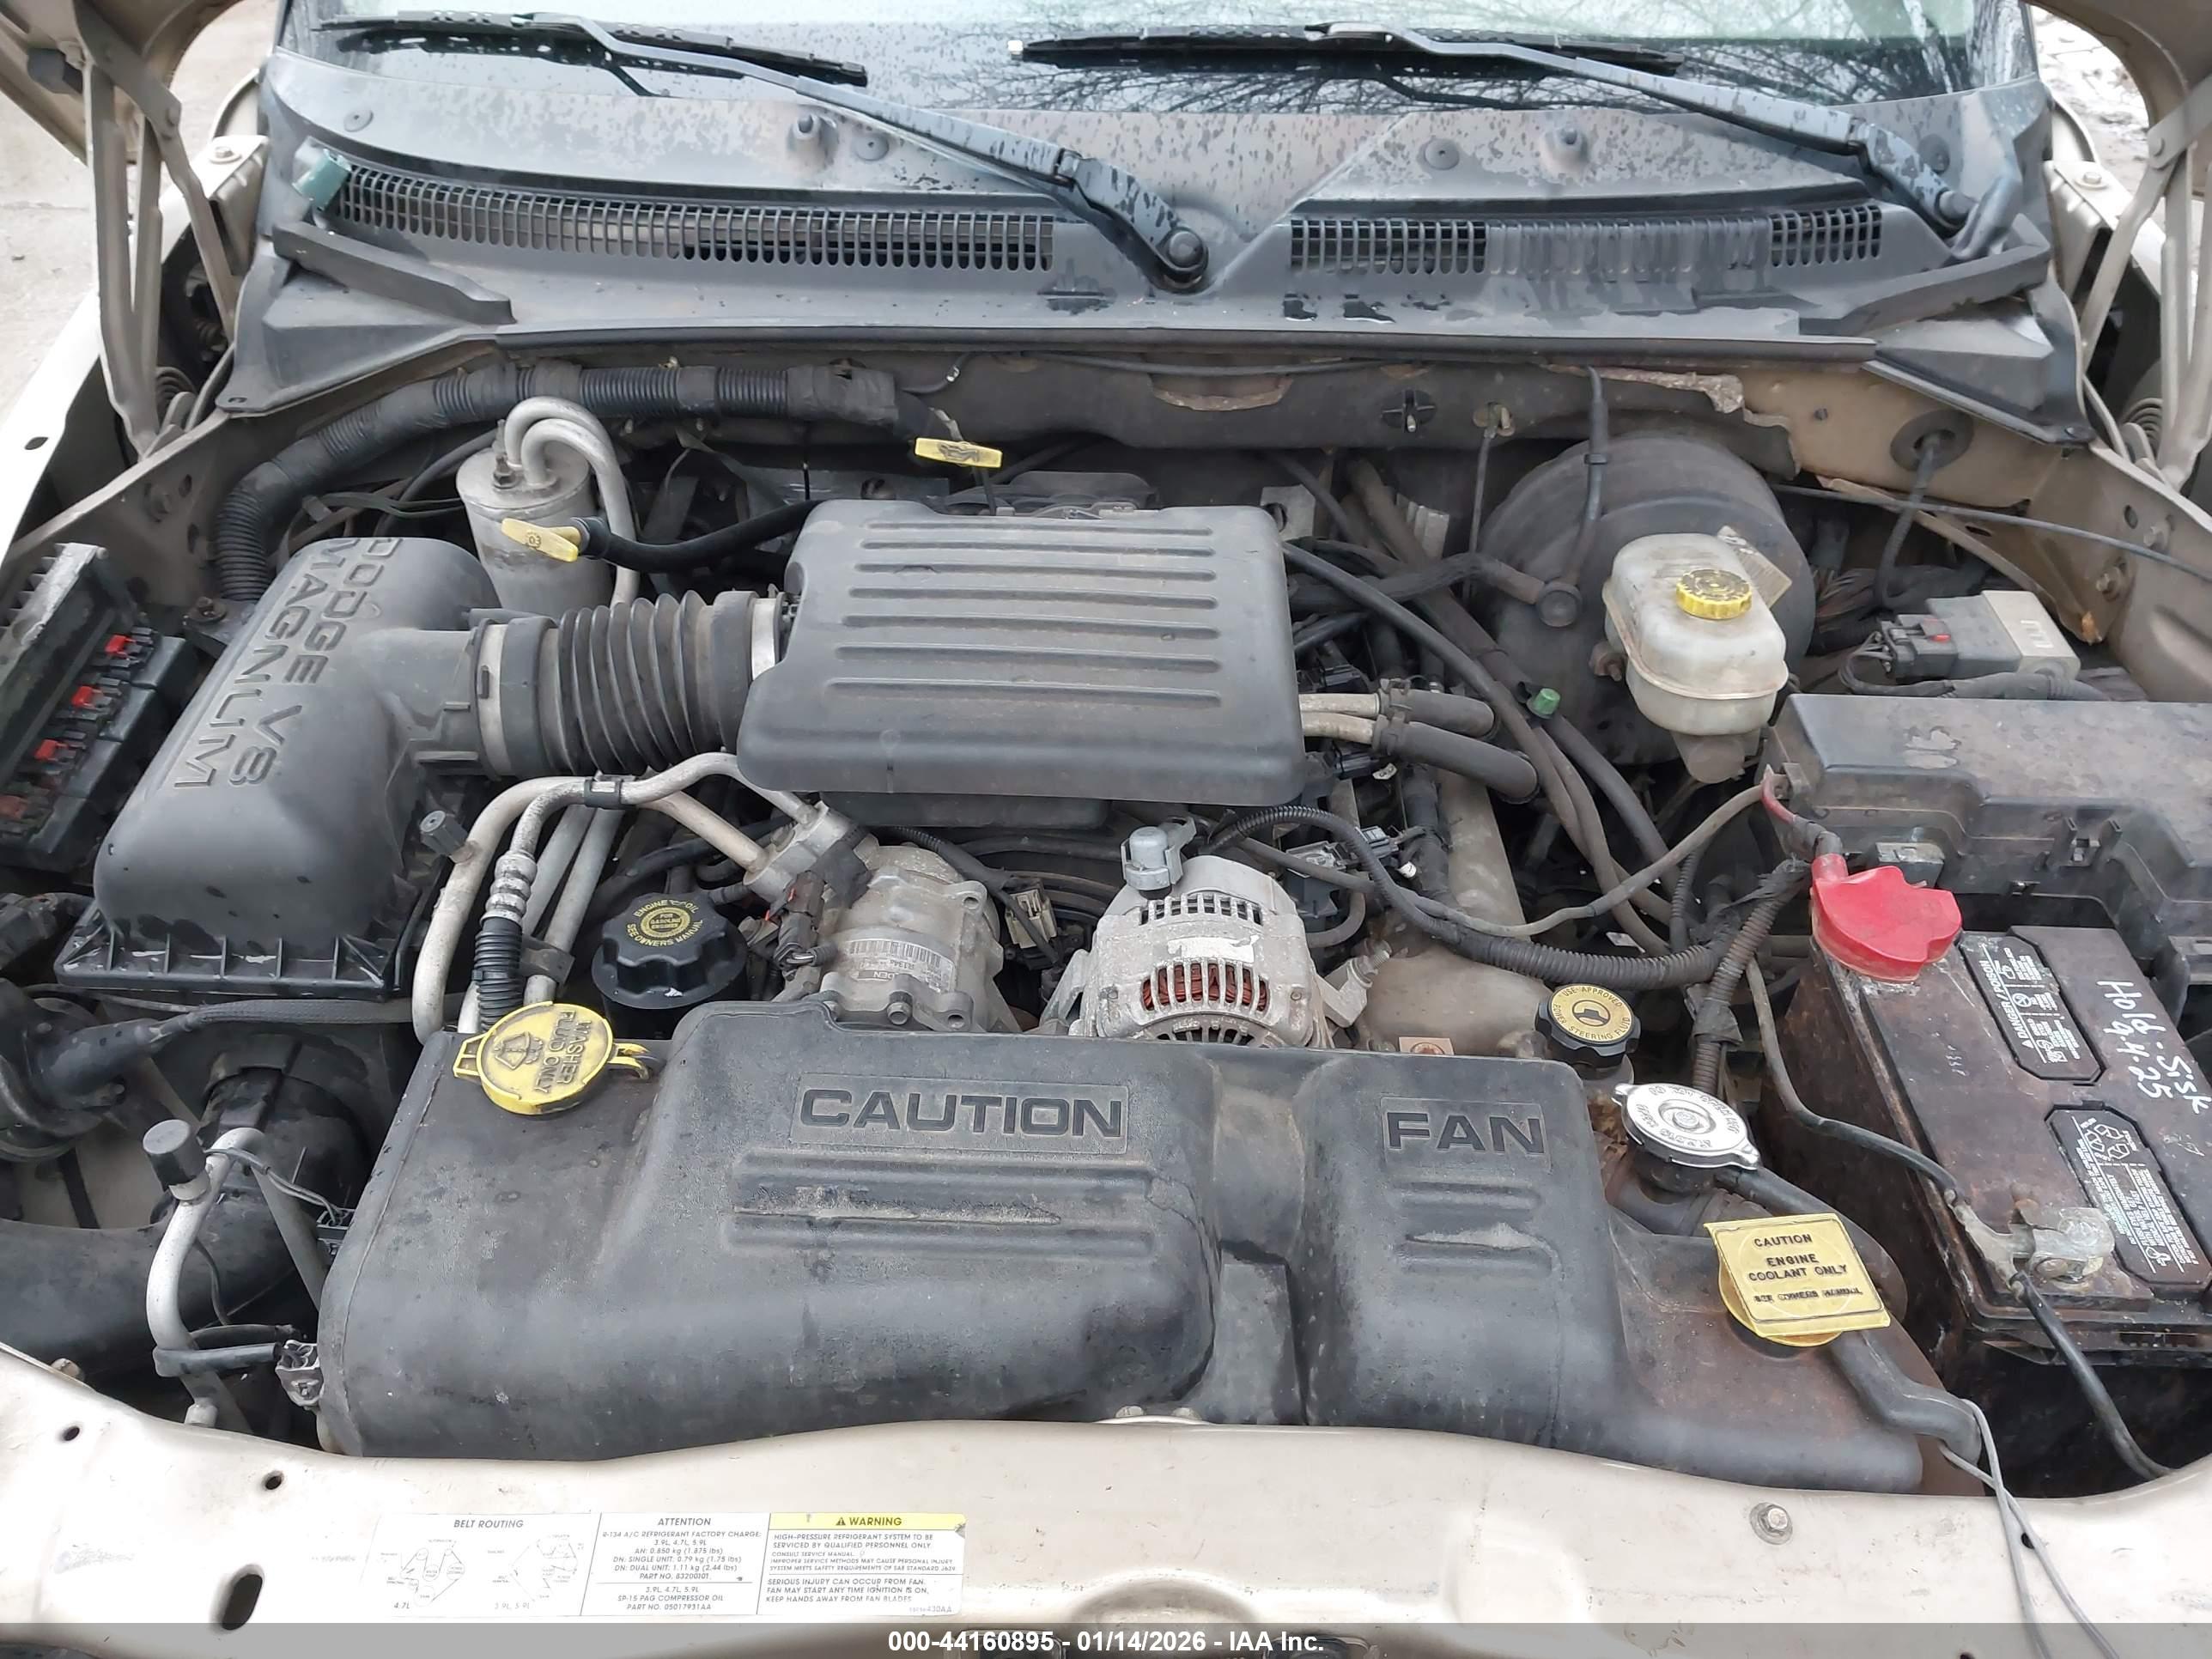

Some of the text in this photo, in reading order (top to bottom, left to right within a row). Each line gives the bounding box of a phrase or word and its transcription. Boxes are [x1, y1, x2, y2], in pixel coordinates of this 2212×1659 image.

[173, 539, 360, 787] MAGNUM
[228, 537, 403, 786] DODGE V8
[634, 900, 699, 917] ENGINE OIL
[627, 920, 702, 946] SEE OWNERS MANUAL
[1562, 987, 1622, 1007] USE APPROVED
[1553, 1004, 1630, 1040] POWER STEERING FLUID
[534, 1010, 576, 1093] FLUID ONLY
[557, 1021, 592, 1085] WASHER
[2097, 981, 2166, 1035] Hold
[2156, 1056, 2212, 1114] Sisk
[799, 1089, 1122, 1138] CAUTION
[1386, 1111, 1545, 1155] FAN
[1754, 1233, 1813, 1248] CAUTION
[1747, 1264, 1847, 1281] COOLANT ONLY
[1766, 1254, 1820, 1267] ENGINE
[453, 1519, 524, 1528] BELT ROUTING
